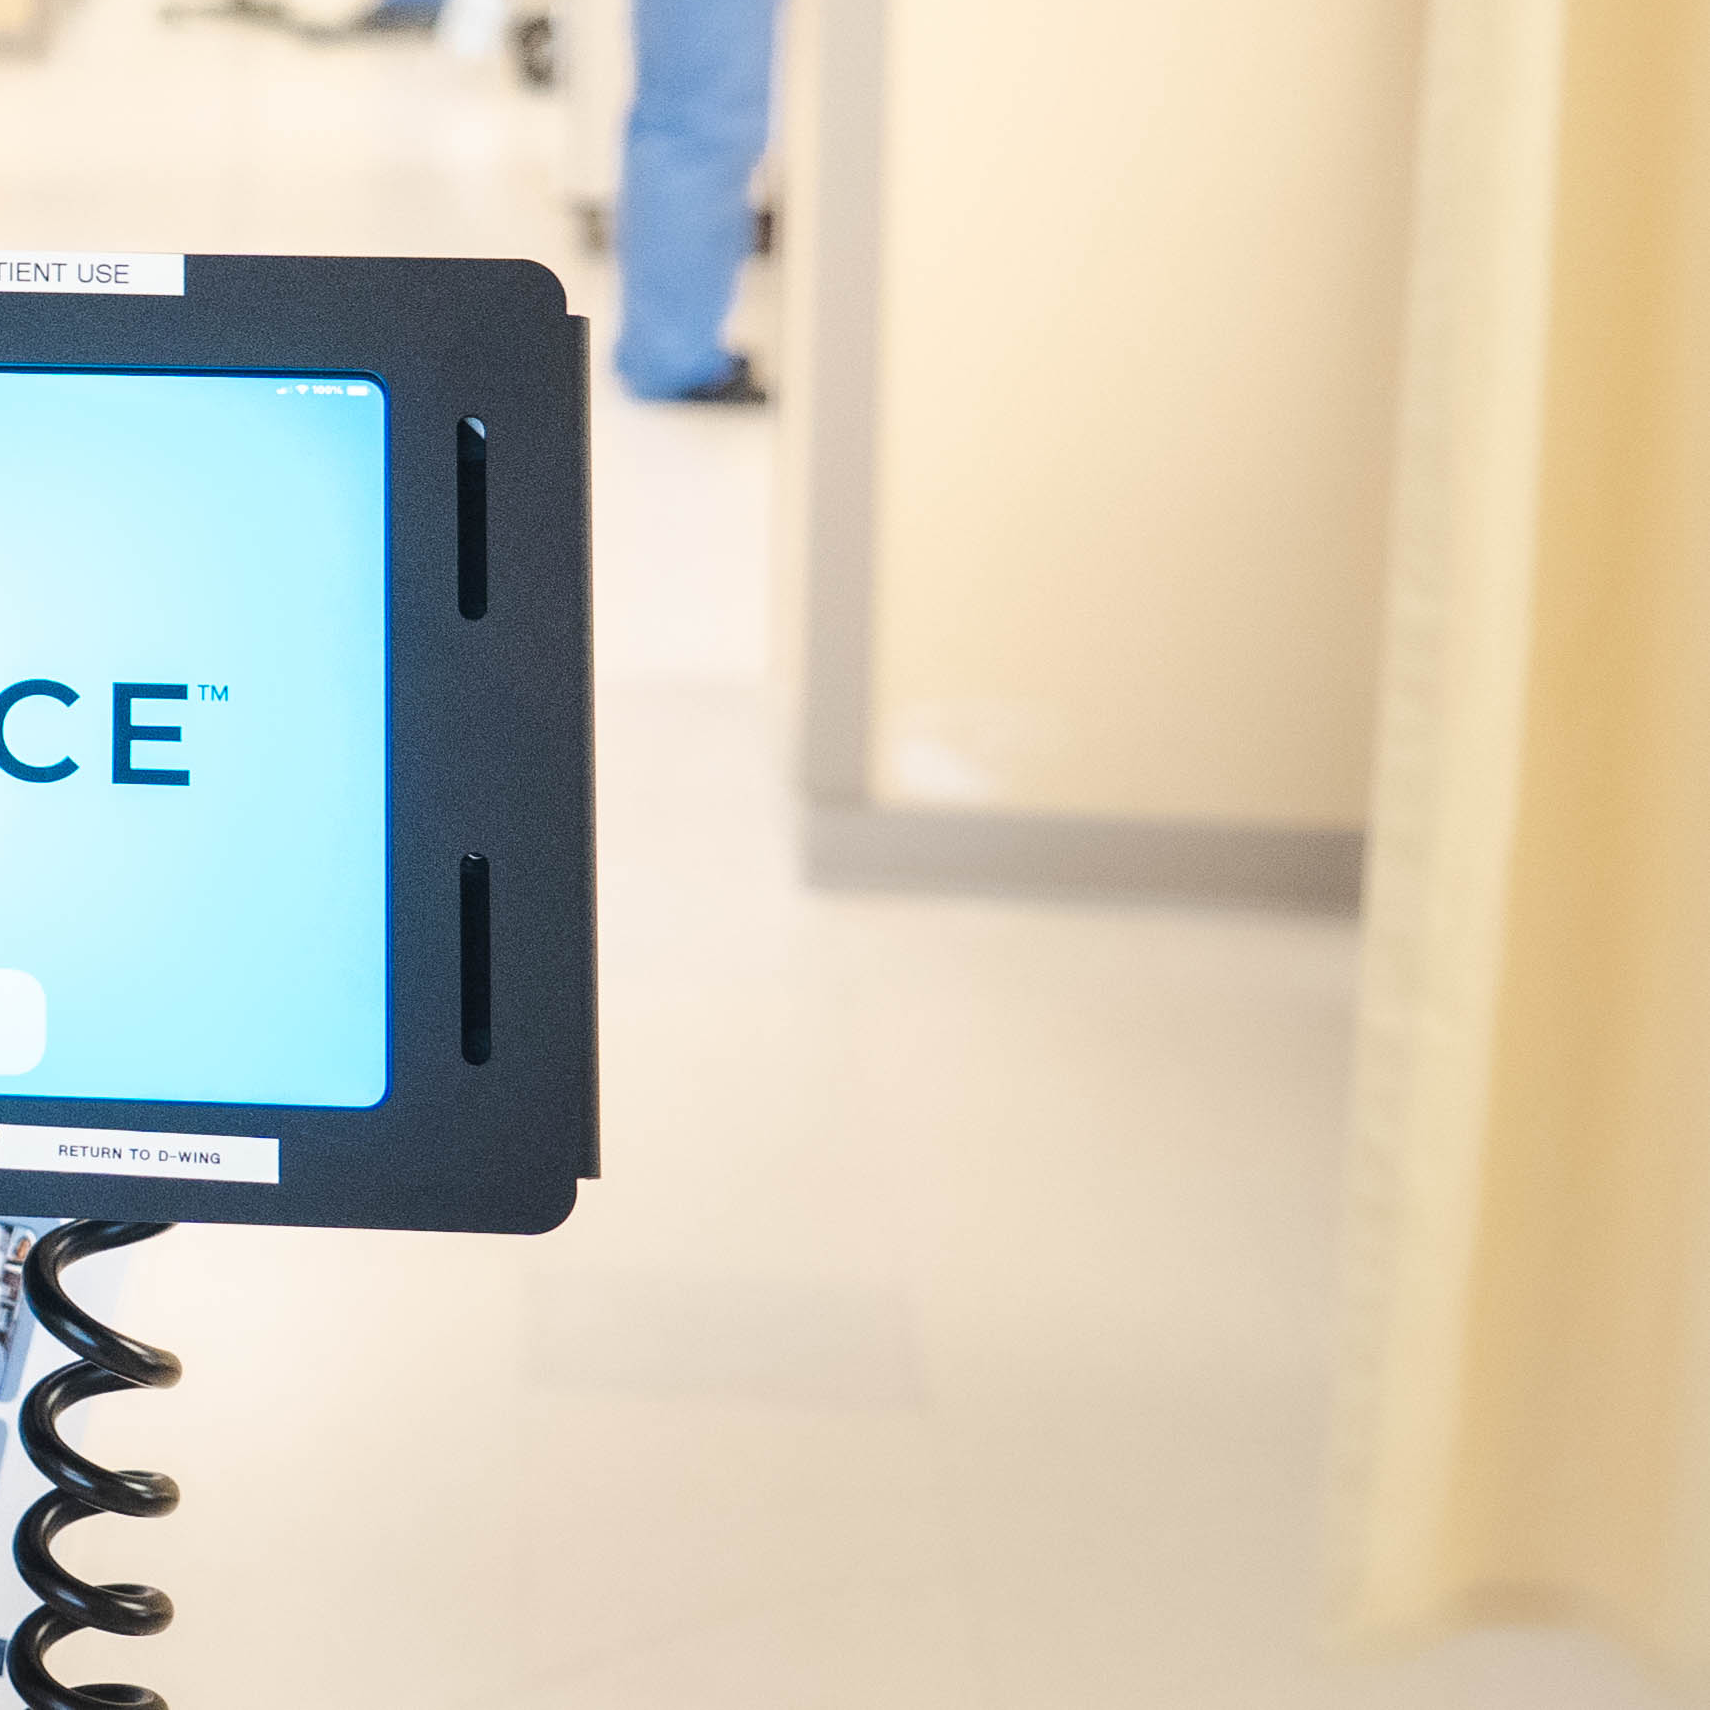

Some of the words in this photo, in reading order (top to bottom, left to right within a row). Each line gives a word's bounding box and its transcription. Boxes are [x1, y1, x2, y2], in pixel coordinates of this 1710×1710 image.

[77, 264, 130, 285] USE
[59, 1144, 123, 1161] RETURN
[130, 1147, 152, 1162] TO
[158, 1148, 222, 1165] D-WING
